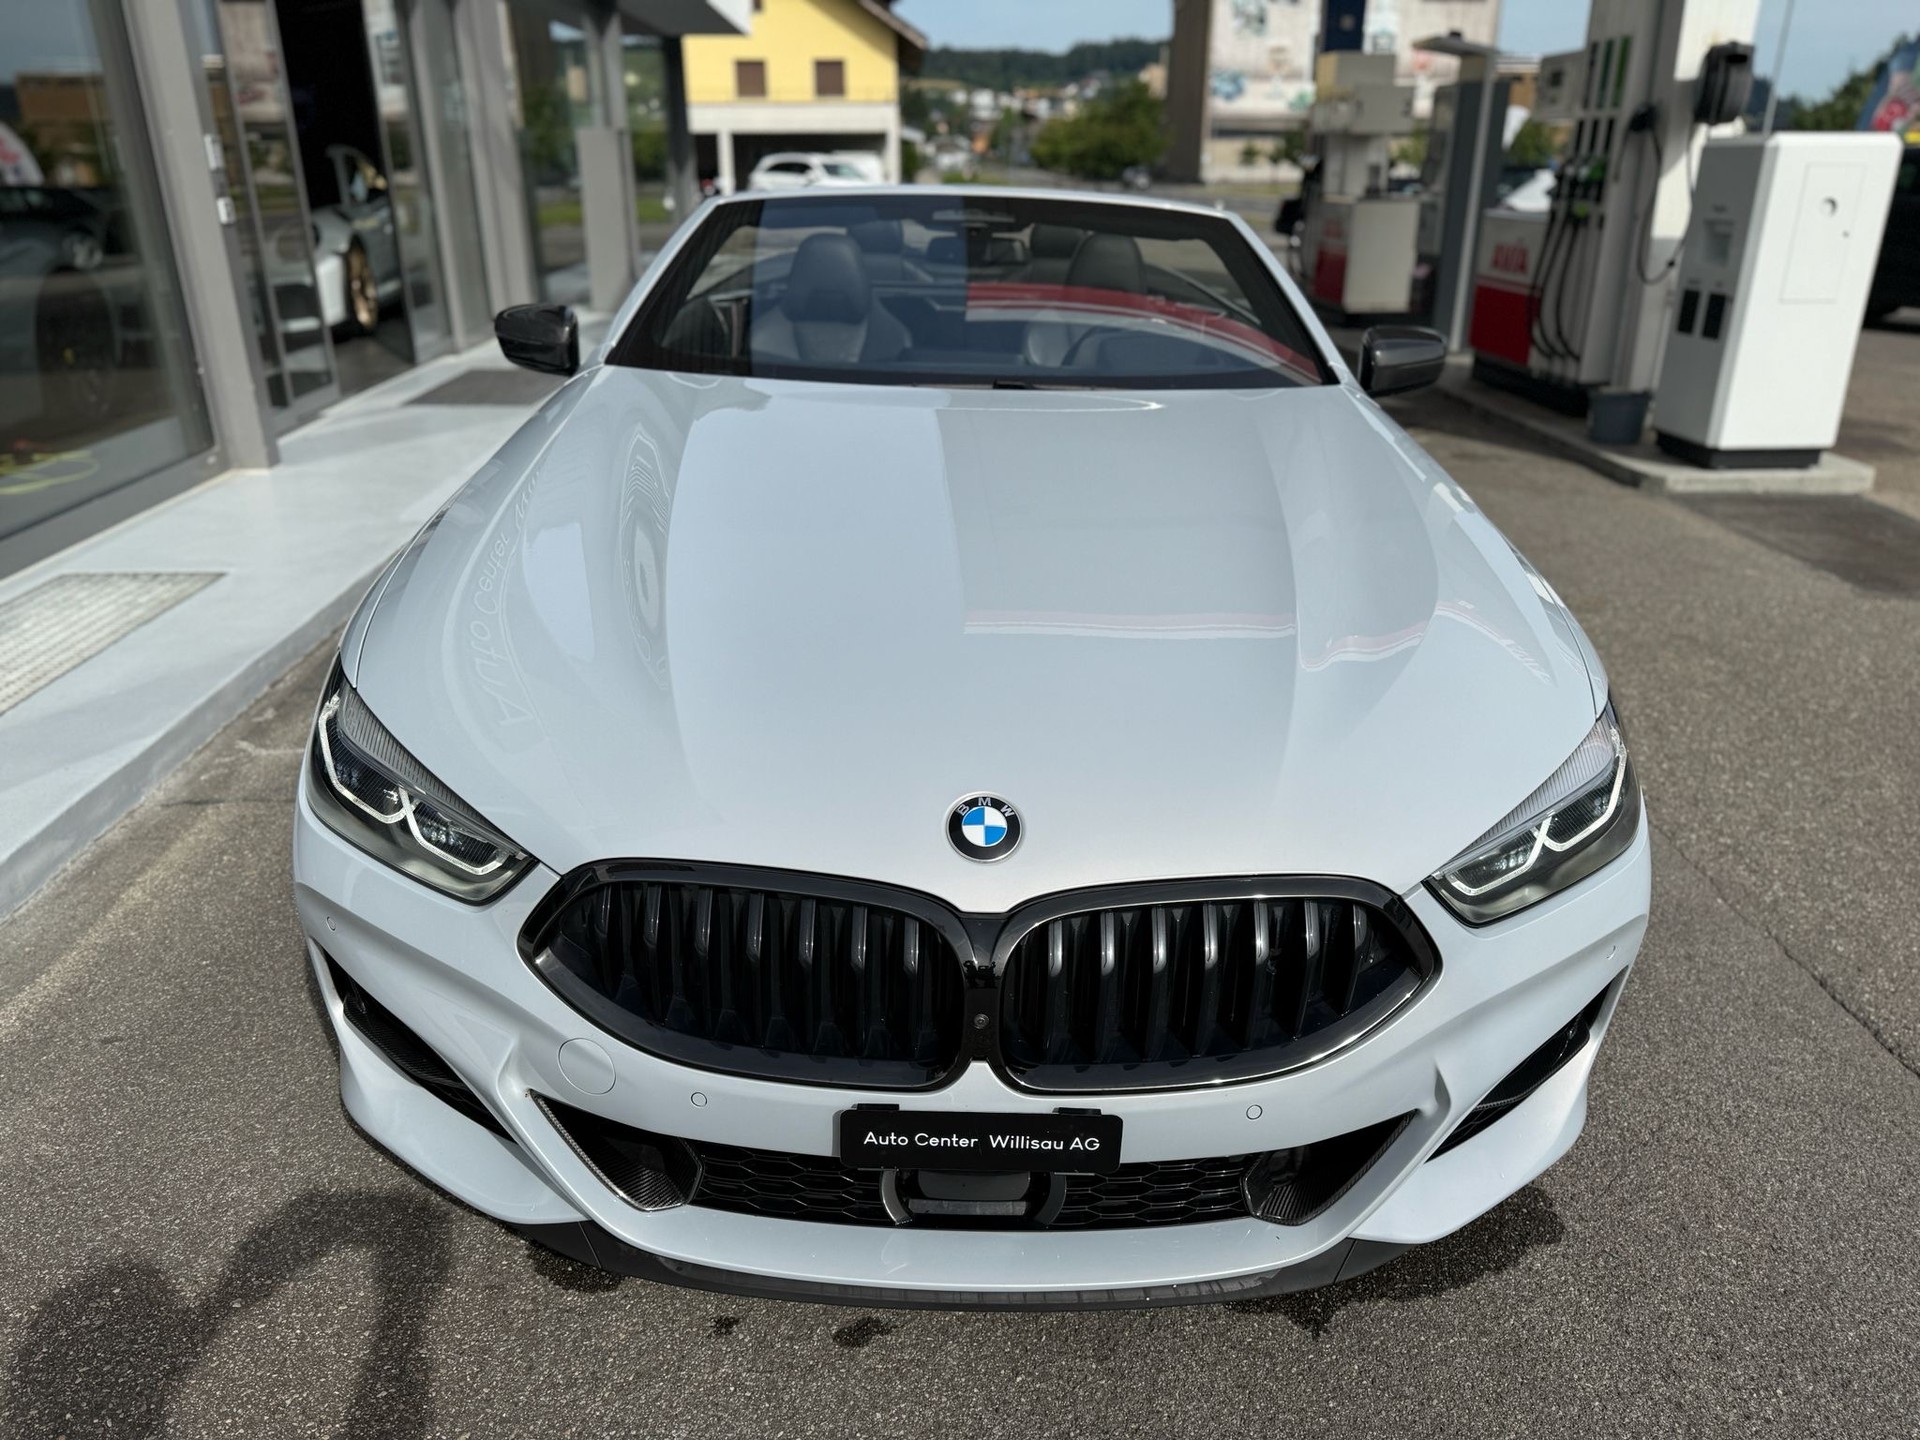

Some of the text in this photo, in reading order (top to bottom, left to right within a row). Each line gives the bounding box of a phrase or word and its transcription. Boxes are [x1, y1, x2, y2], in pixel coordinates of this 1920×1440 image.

[957, 797, 1015, 817] BMW
[863, 1131, 1100, 1151] Auto Center Willisau AG
